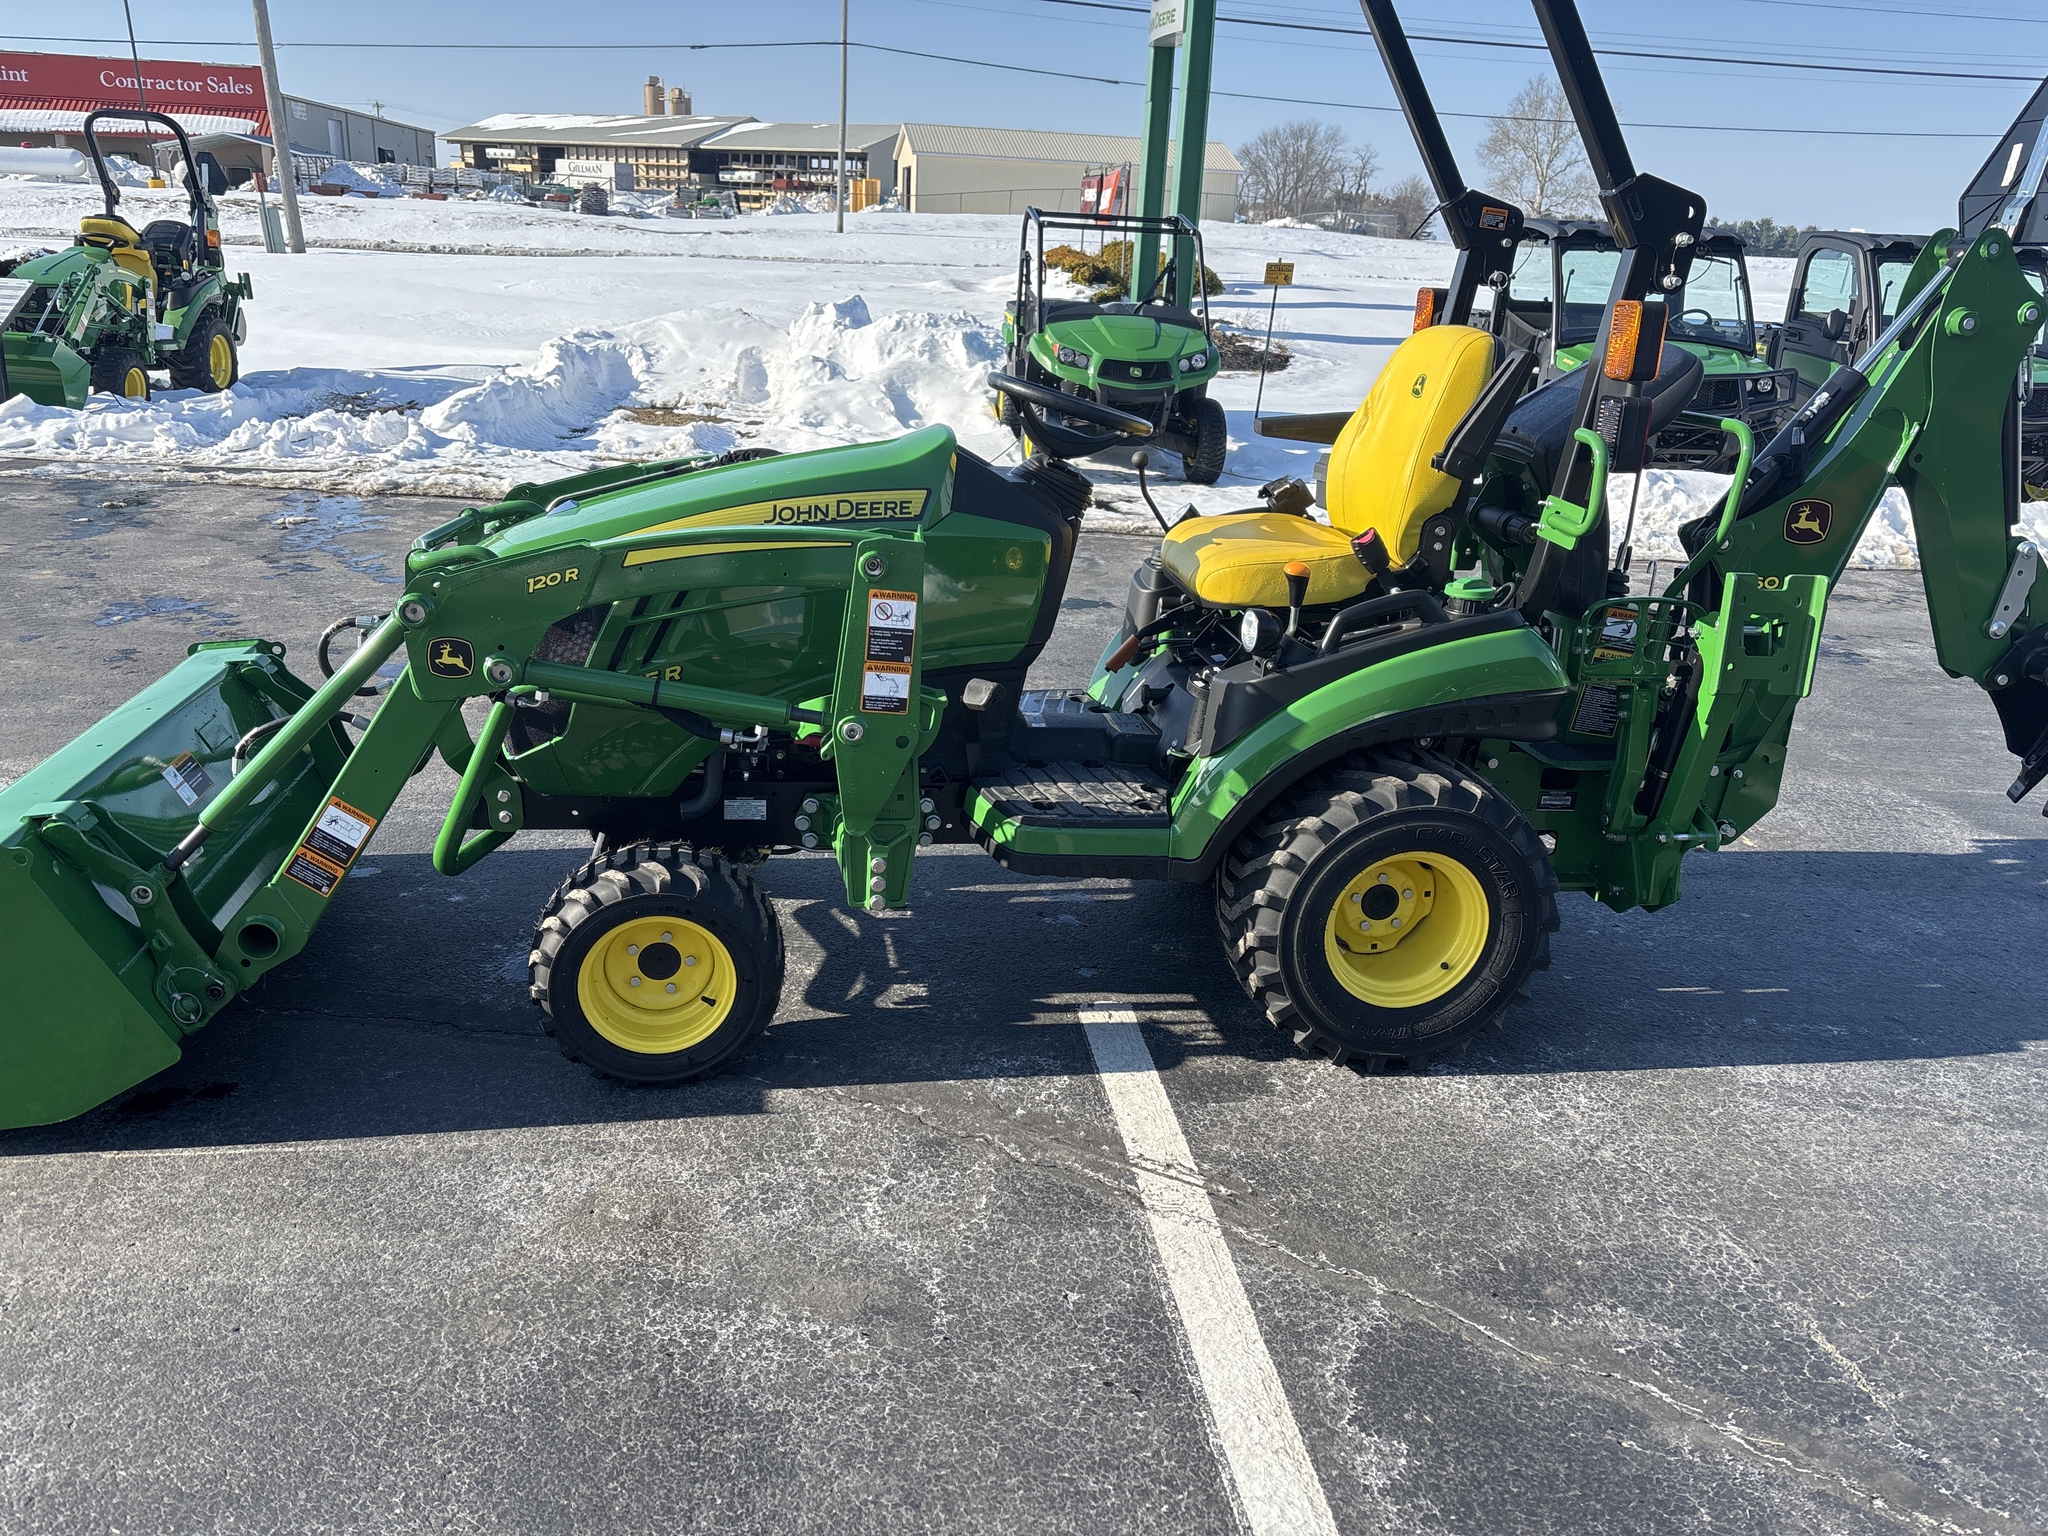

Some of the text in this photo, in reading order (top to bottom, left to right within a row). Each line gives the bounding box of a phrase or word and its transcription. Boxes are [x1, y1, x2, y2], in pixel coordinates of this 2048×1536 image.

[0, 65, 29, 82] int
[100, 70, 253, 95] Contractor Sales
[568, 161, 603, 174] GILLMAN
[763, 499, 913, 524] JOHN DEERE
[879, 591, 916, 601] WARNING
[1617, 611, 1638, 619] WARN
[873, 664, 910, 673] WARNING
[341, 804, 371, 824] WARNING
[309, 855, 339, 874] WARNING
